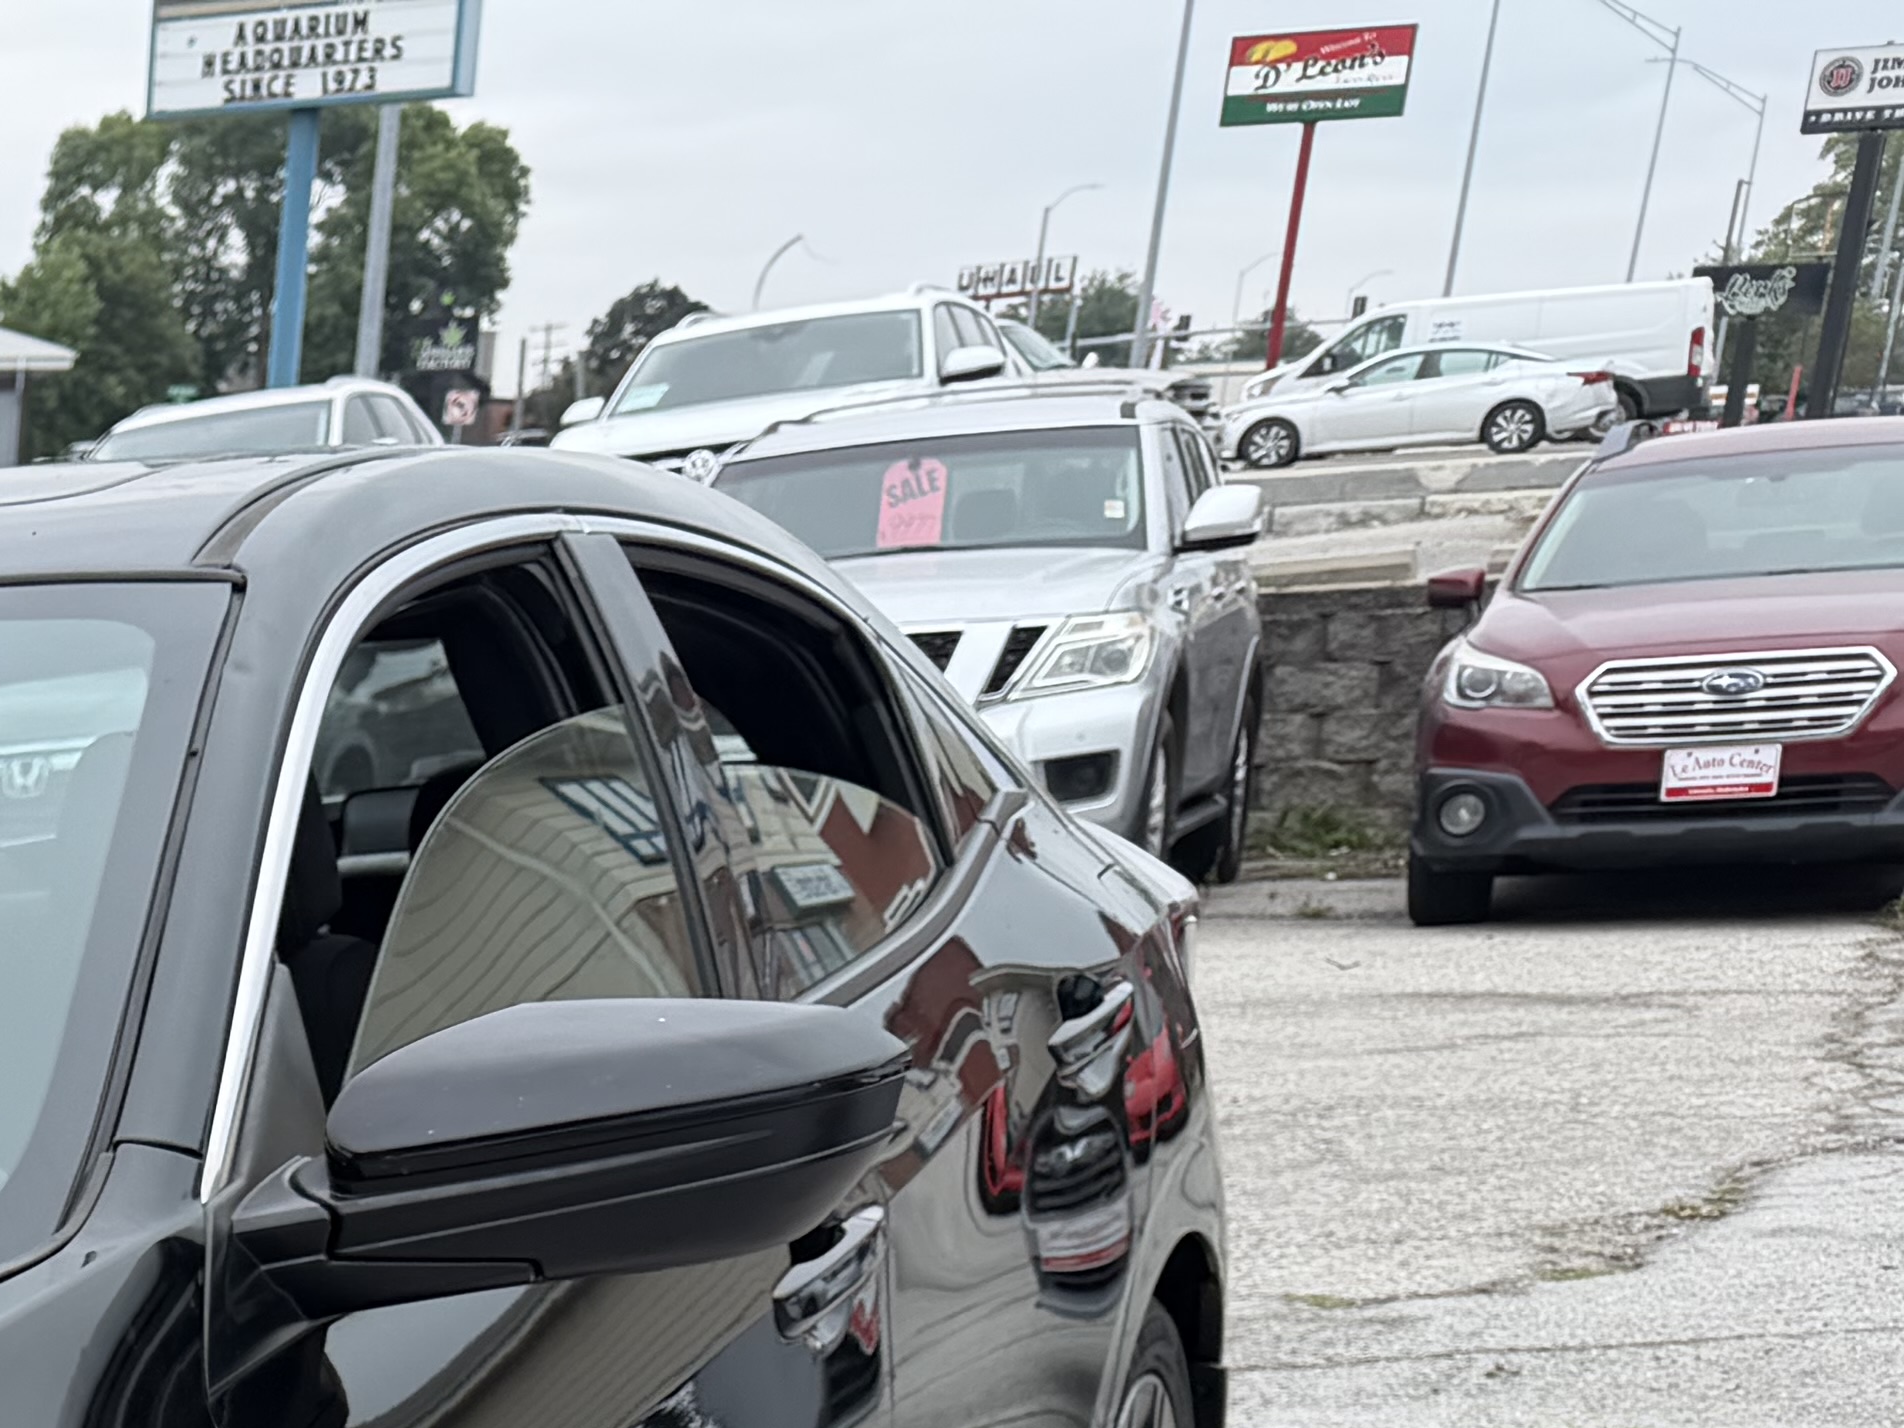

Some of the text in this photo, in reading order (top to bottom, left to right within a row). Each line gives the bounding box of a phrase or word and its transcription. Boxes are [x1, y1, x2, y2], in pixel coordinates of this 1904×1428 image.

[233, 10, 370, 47] AQUARIUM
[201, 35, 404, 78] HEADQUARTERS
[222, 66, 378, 101] SINCE 1973
[1819, 111, 1876, 123] DRIVE
[887, 468, 941, 508] SALE
[1692, 757, 1725, 772] Auto
[1729, 752, 1774, 774] Center
